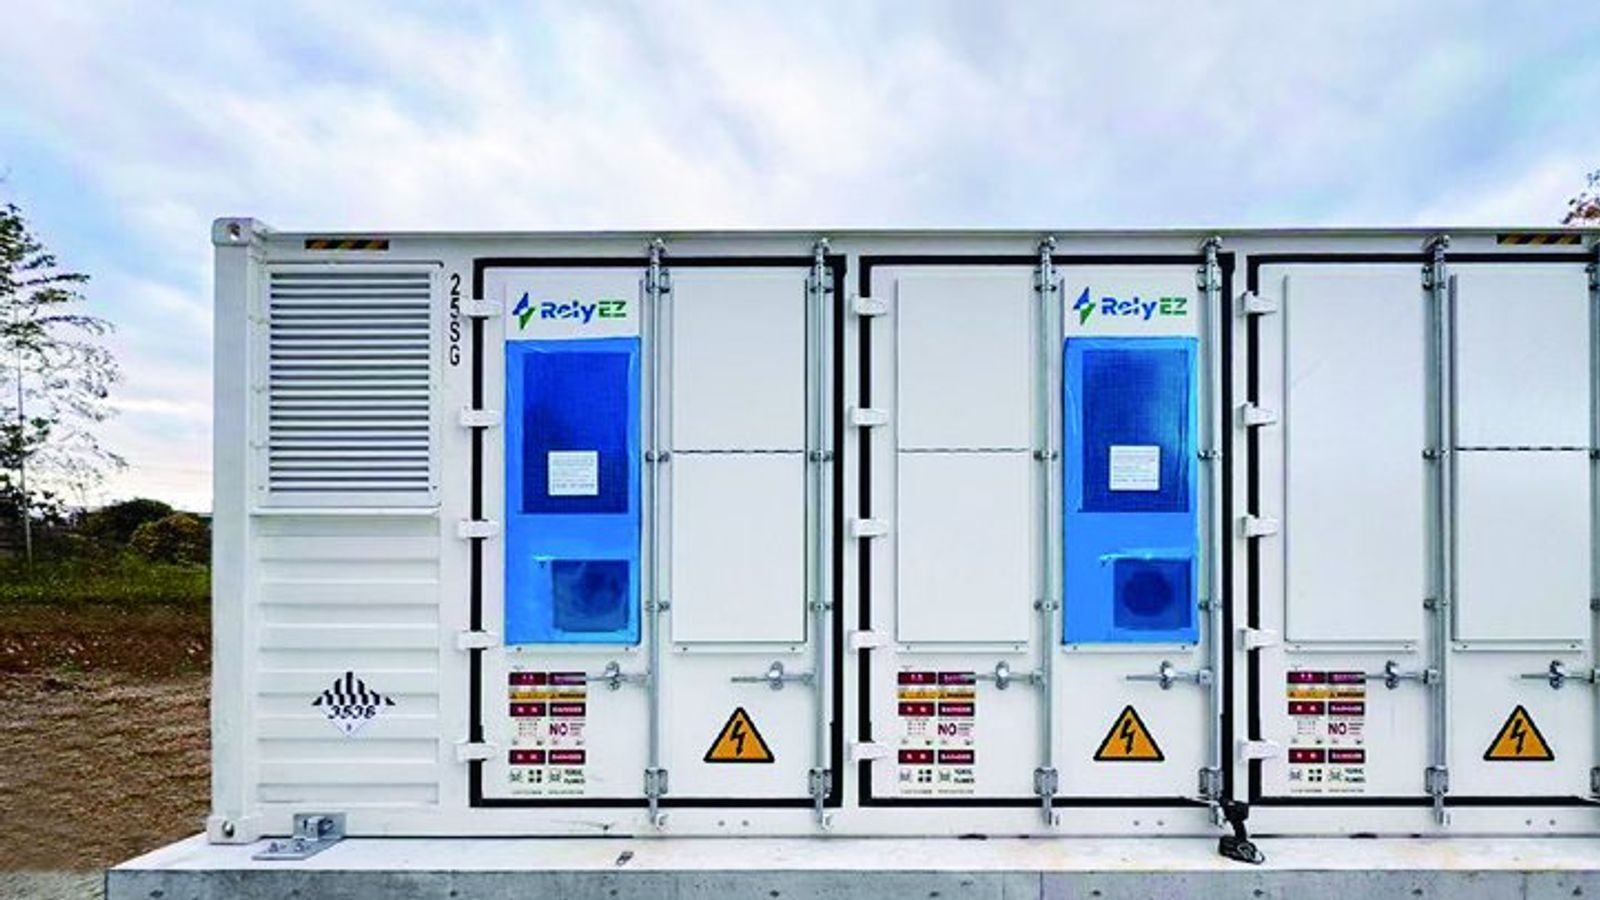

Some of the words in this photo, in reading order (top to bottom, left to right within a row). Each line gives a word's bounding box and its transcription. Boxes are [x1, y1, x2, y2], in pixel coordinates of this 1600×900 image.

[541, 300, 627, 324] RelyEZ
[1101, 296, 1187, 321] RelyEZ
[549, 722, 569, 737] NO
[938, 722, 958, 737] NO
[1328, 722, 1347, 736] NO
